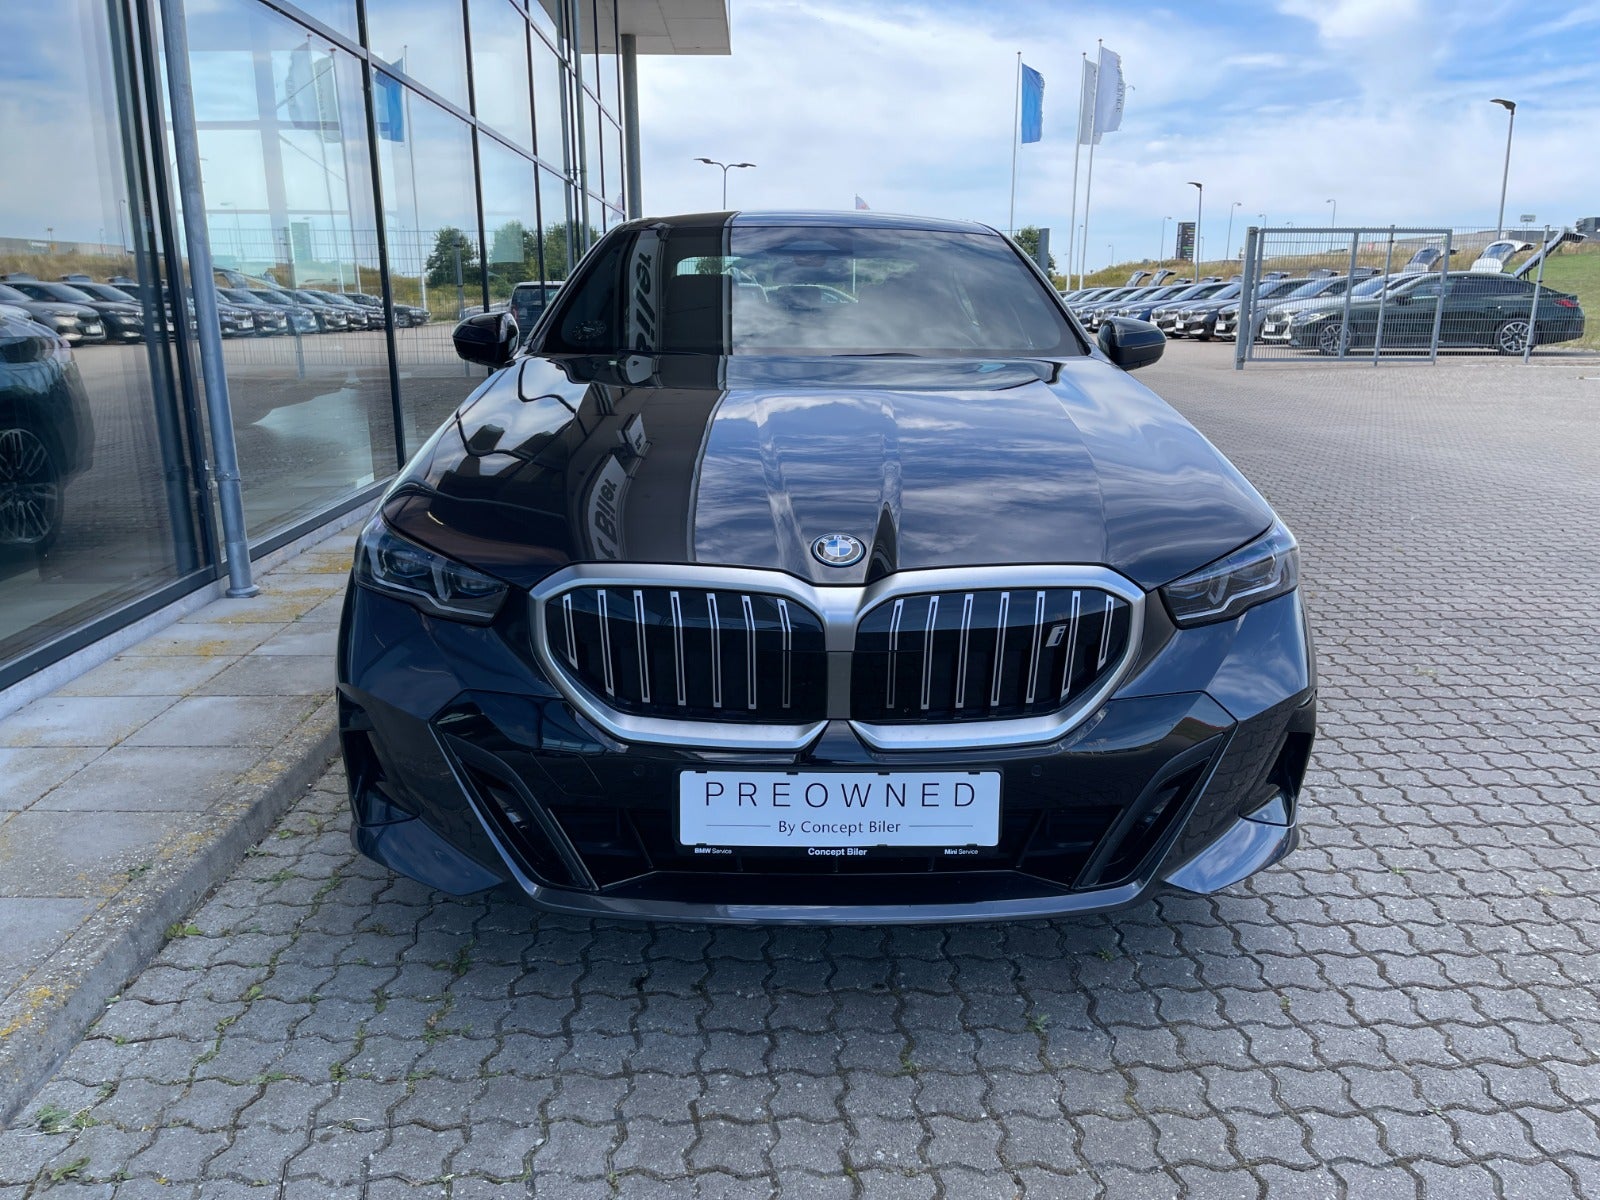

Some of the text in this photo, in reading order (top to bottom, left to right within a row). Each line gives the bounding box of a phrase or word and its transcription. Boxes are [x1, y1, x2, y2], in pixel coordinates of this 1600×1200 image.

[705, 781, 976, 808] PREOWNED
[778, 820, 901, 837] By Concept Biler
[807, 847, 868, 857] Concept Biler
